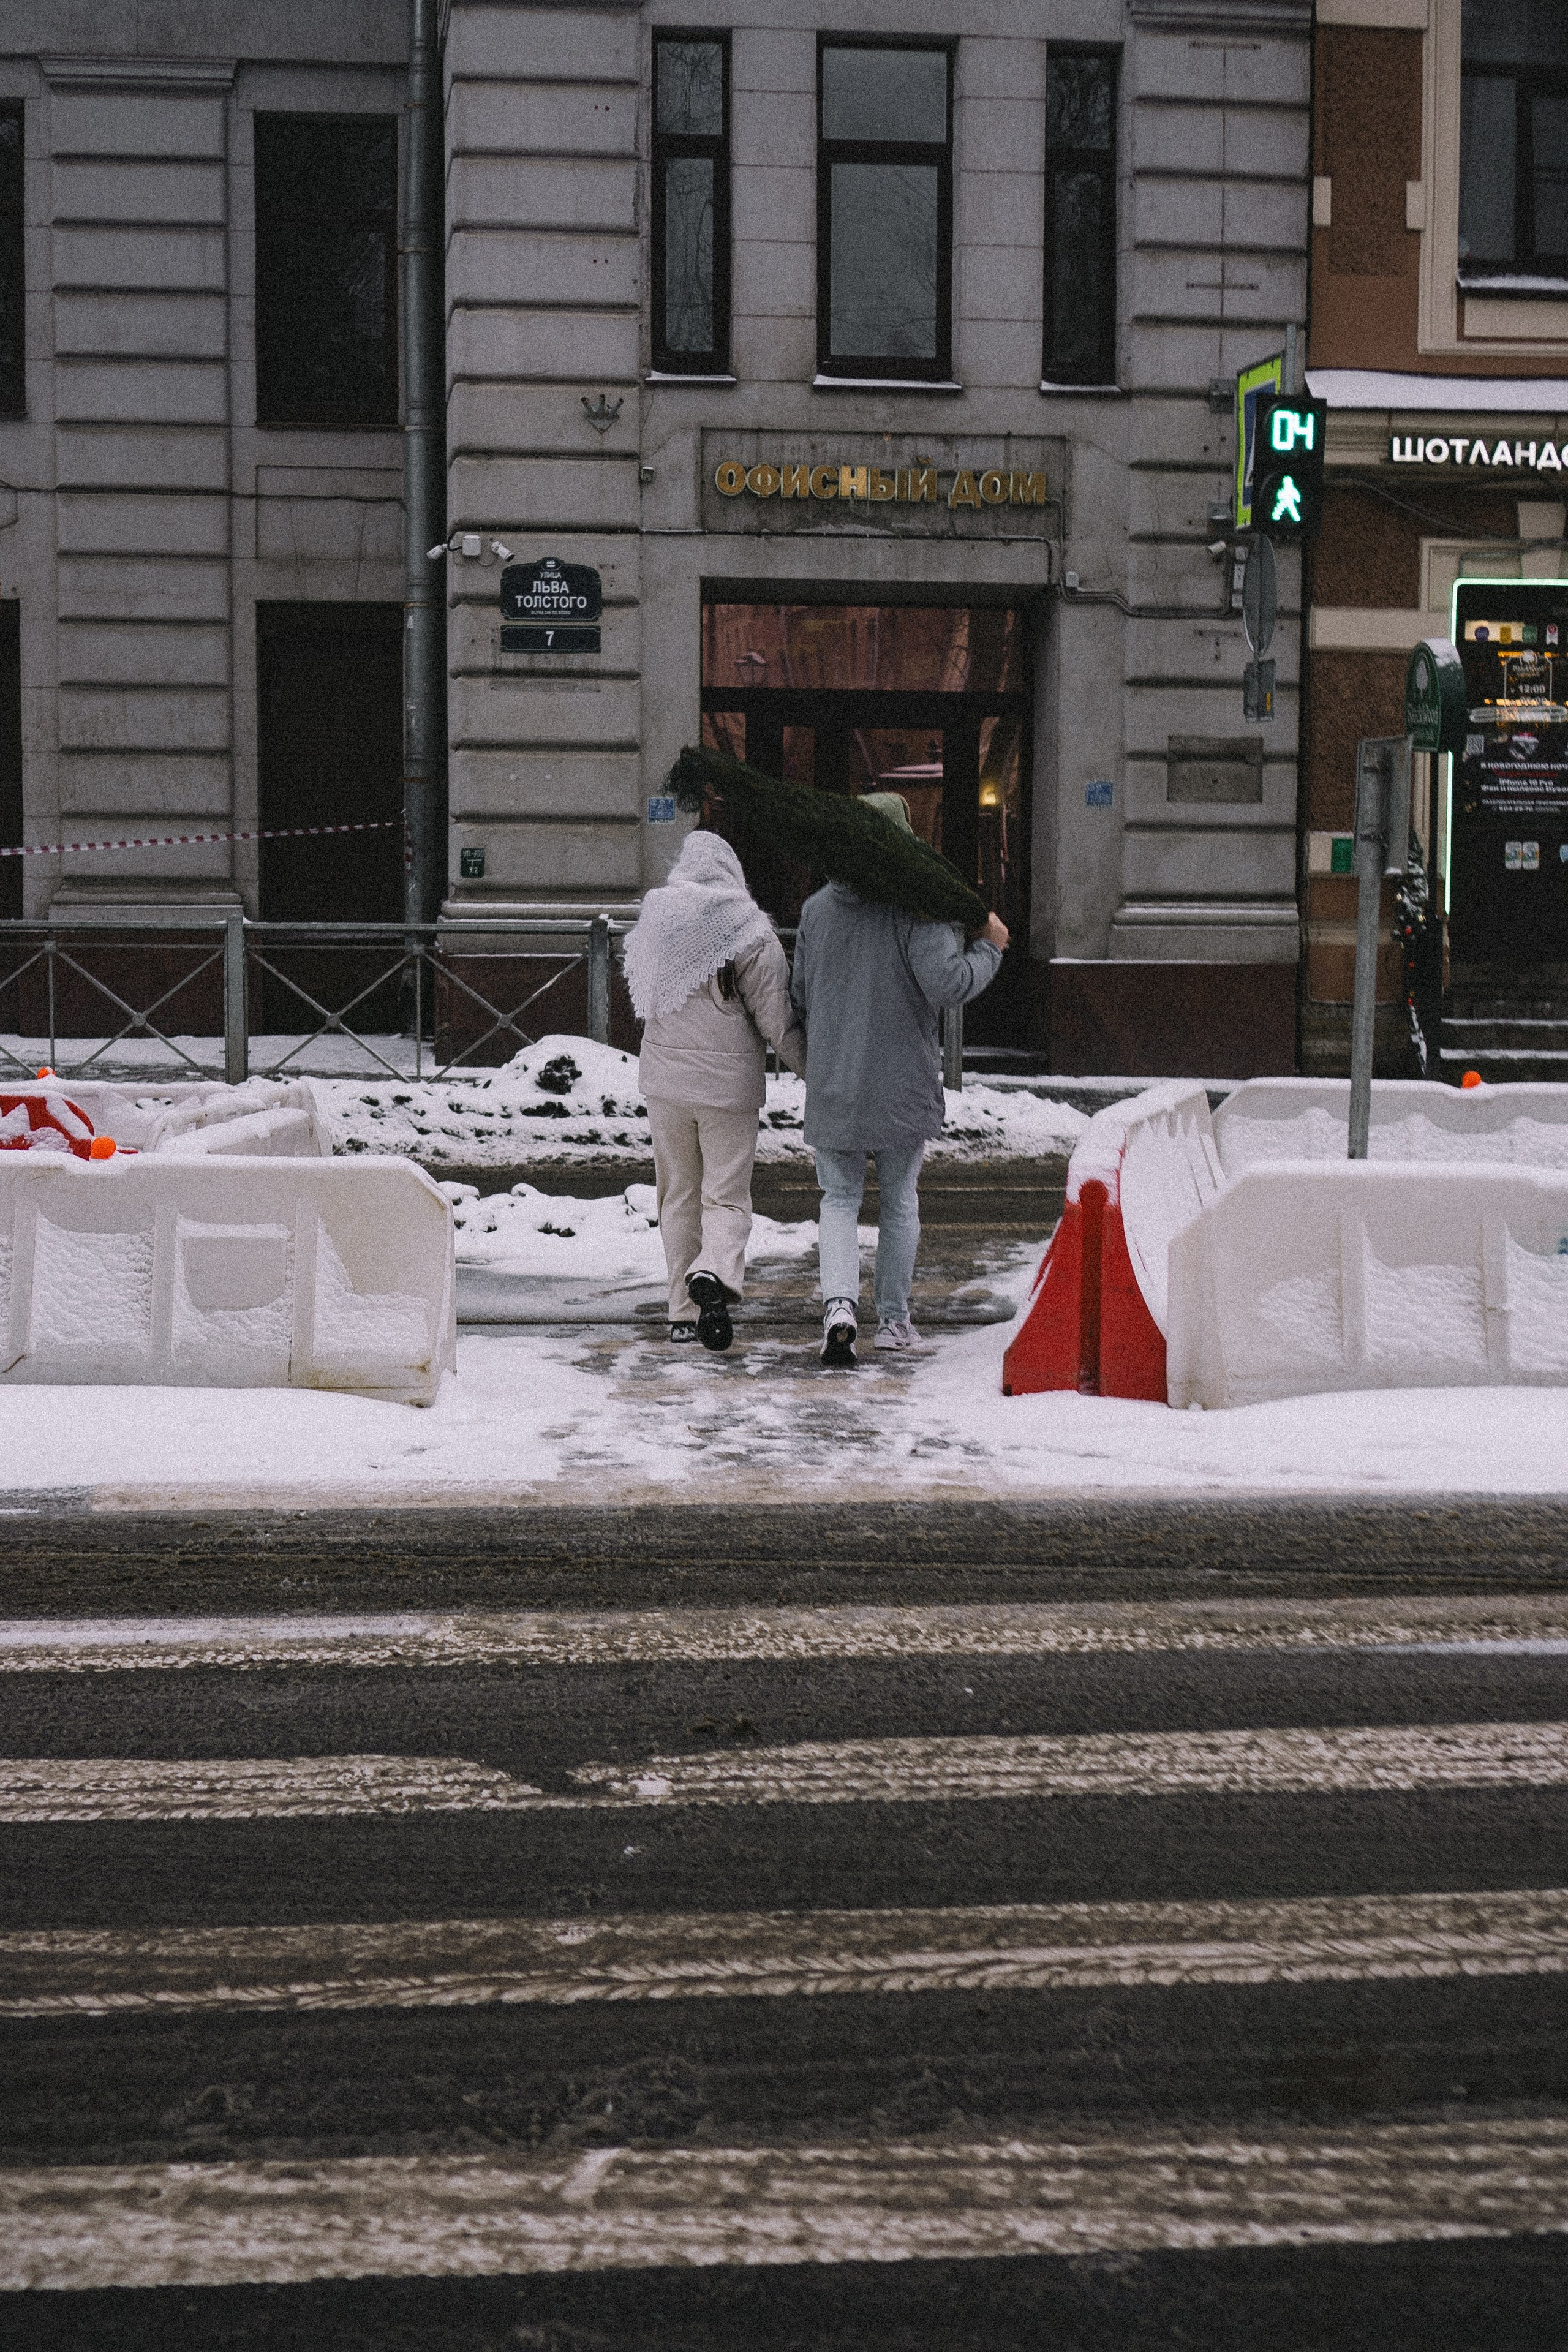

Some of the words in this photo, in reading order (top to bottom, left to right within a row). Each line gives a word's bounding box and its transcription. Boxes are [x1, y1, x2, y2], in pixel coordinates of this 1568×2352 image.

[1272, 409, 1314, 451] 04
[1392, 437, 1568, 472] ШОТЛАНД
[715, 455, 938, 502] ОФИСНЫЙ
[948, 468, 1047, 509] ДОМ
[532, 581, 570, 594] ЛЬВА
[515, 595, 587, 608] ТОЛСТОГО
[545, 630, 554, 646] 7
